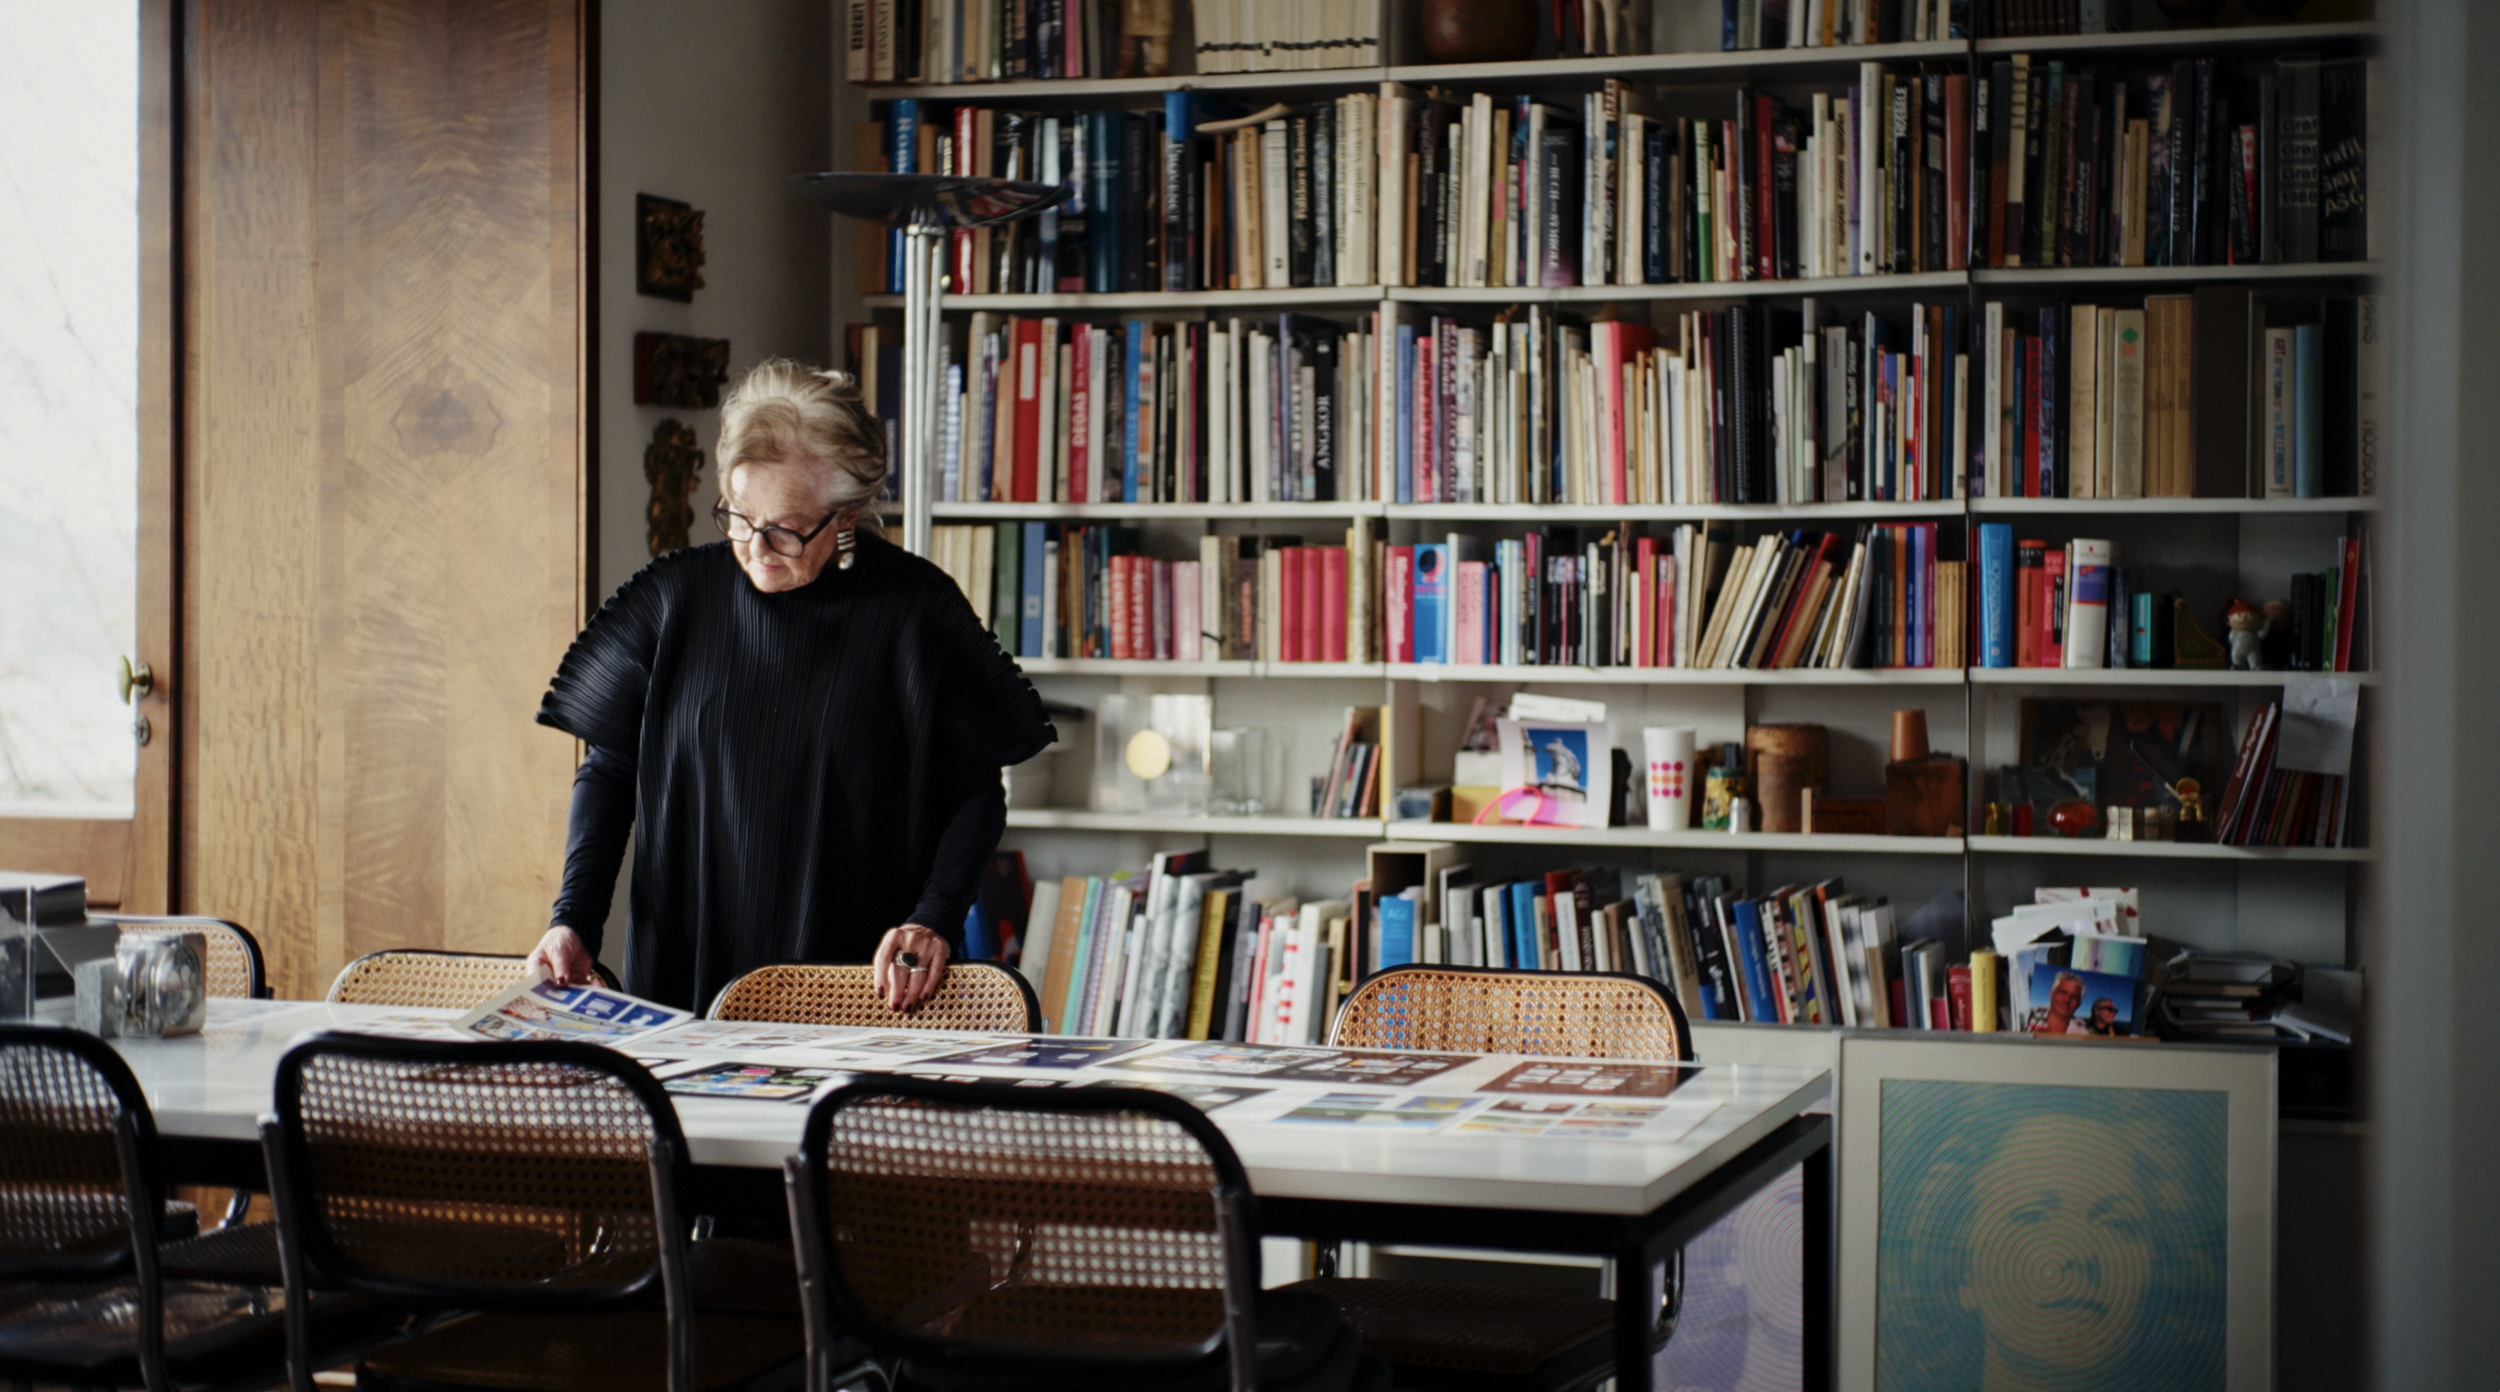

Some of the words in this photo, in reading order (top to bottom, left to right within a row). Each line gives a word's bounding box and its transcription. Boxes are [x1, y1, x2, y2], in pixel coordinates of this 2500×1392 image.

[1167, 143, 1185, 224] PROVENCE
[2273, 337, 2286, 357] ART
[1072, 391, 1089, 447] DEGAS
[1316, 394, 1332, 470] ANGKOR
